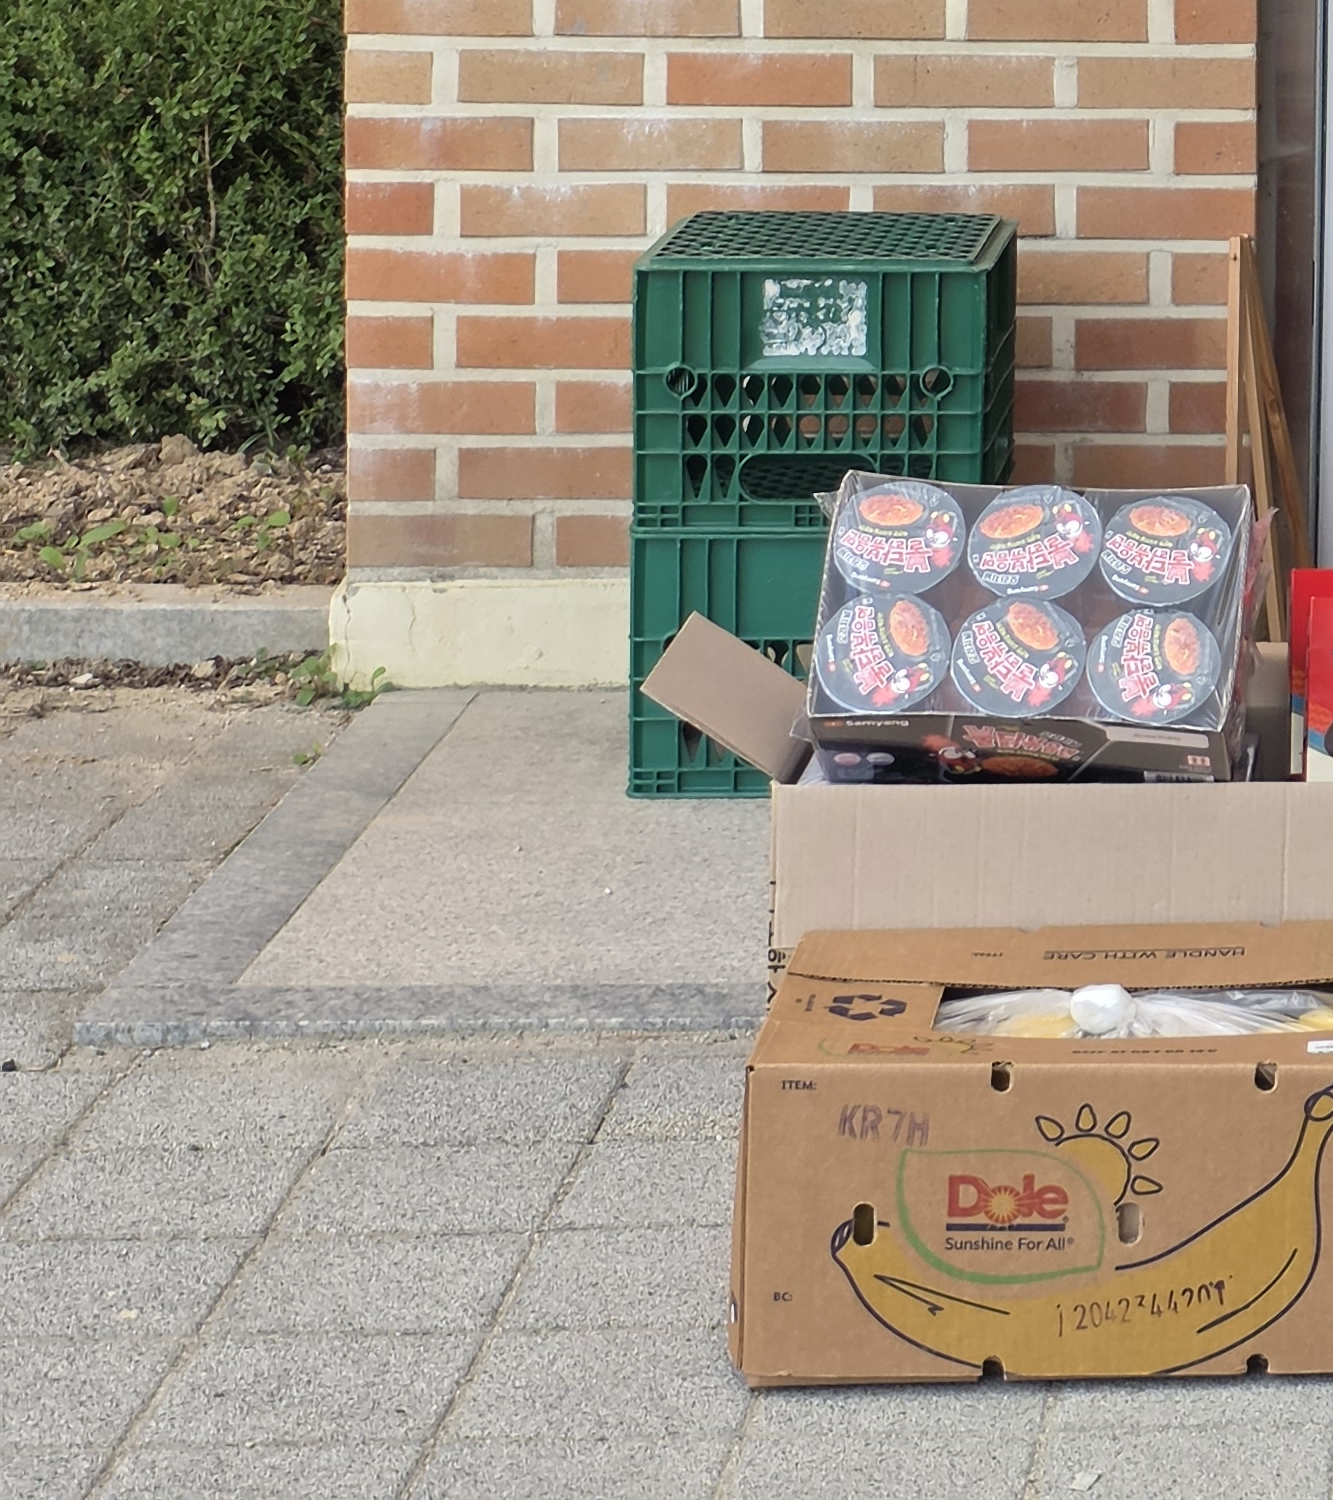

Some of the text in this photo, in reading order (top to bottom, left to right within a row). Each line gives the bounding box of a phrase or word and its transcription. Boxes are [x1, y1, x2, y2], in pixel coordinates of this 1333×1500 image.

[1044, 947, 1246, 961] CARE WITH HANDLE
[781, 1079, 817, 1091] ITEM:
[945, 1173, 1070, 1221] Dole
[944, 1235, 1045, 1251] Sunshine For
